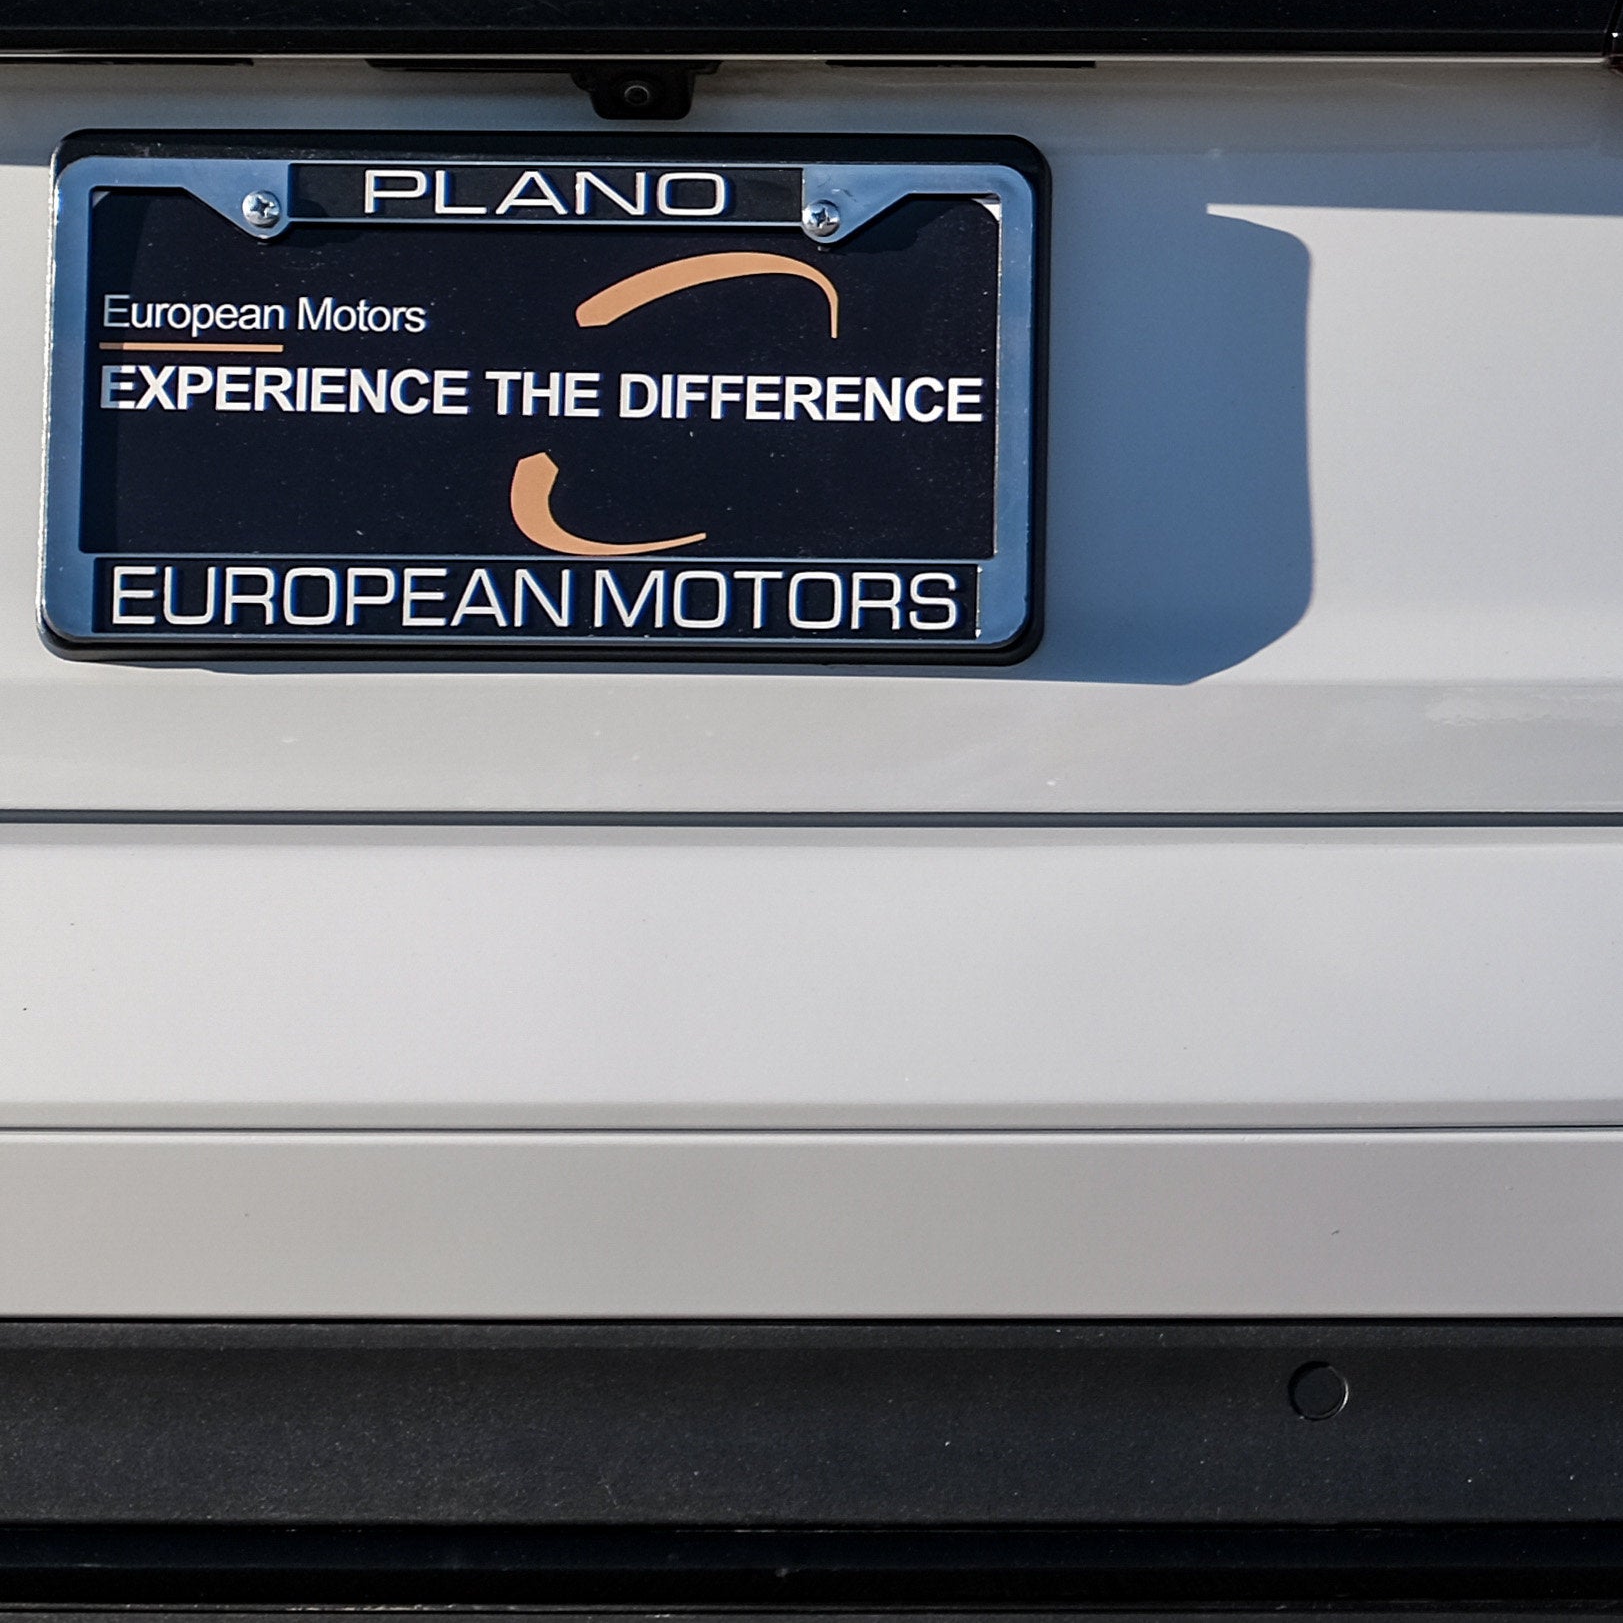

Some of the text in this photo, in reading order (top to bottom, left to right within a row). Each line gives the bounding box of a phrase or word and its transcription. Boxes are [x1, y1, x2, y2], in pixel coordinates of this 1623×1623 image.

[363, 169, 730, 218] PLANO
[103, 294, 426, 337] European Motors
[101, 364, 983, 424] EXPERIENCE THE DIFFERENCE
[112, 566, 957, 630] EUROPEAN MOTORS
